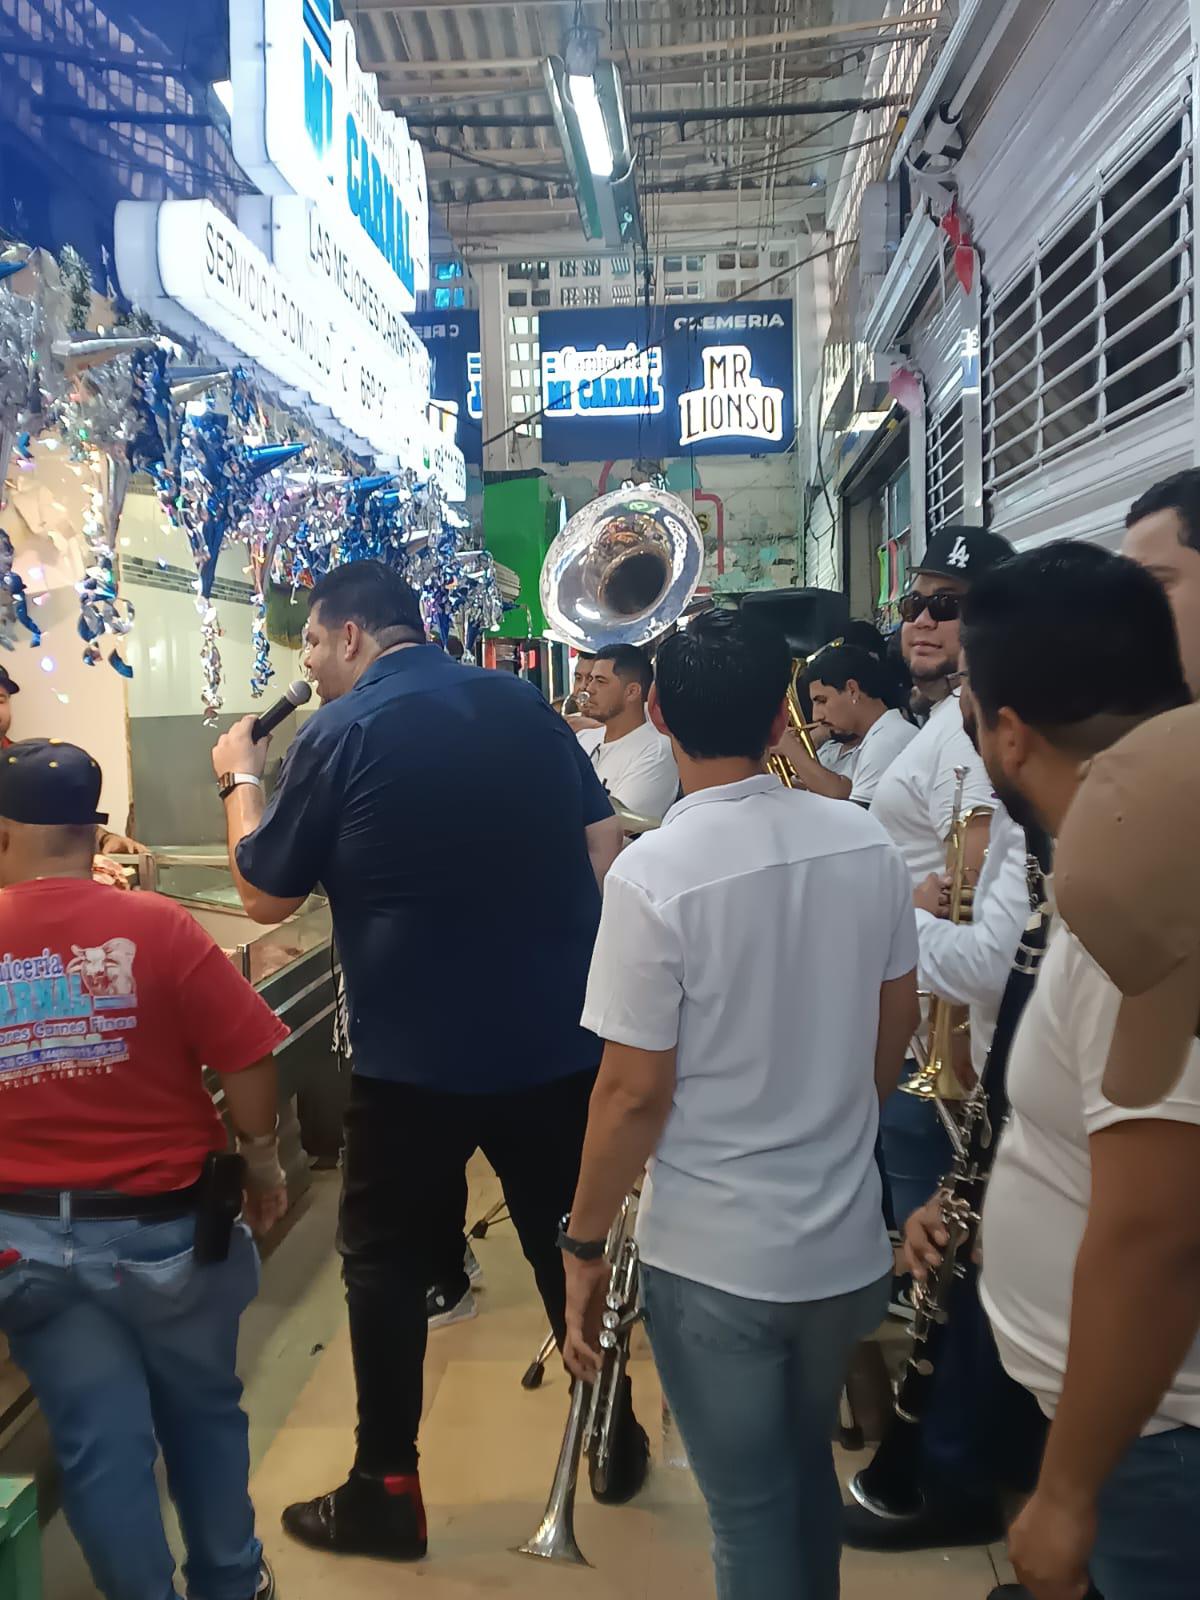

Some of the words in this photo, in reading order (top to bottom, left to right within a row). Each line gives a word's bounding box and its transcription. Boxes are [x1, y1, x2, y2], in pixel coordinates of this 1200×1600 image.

[303, 36, 333, 159] MI
[346, 112, 415, 299] CARNAL
[309, 212, 331, 277] LAS
[206, 221, 267, 323] SERVICIO
[709, 353, 747, 390] MR
[547, 380, 572, 410] MI
[578, 376, 661, 409] CARNAL
[686, 393, 775, 439] LIONSO
[946, 535, 970, 568] LA
[33, 1021, 87, 1039] Carnes
